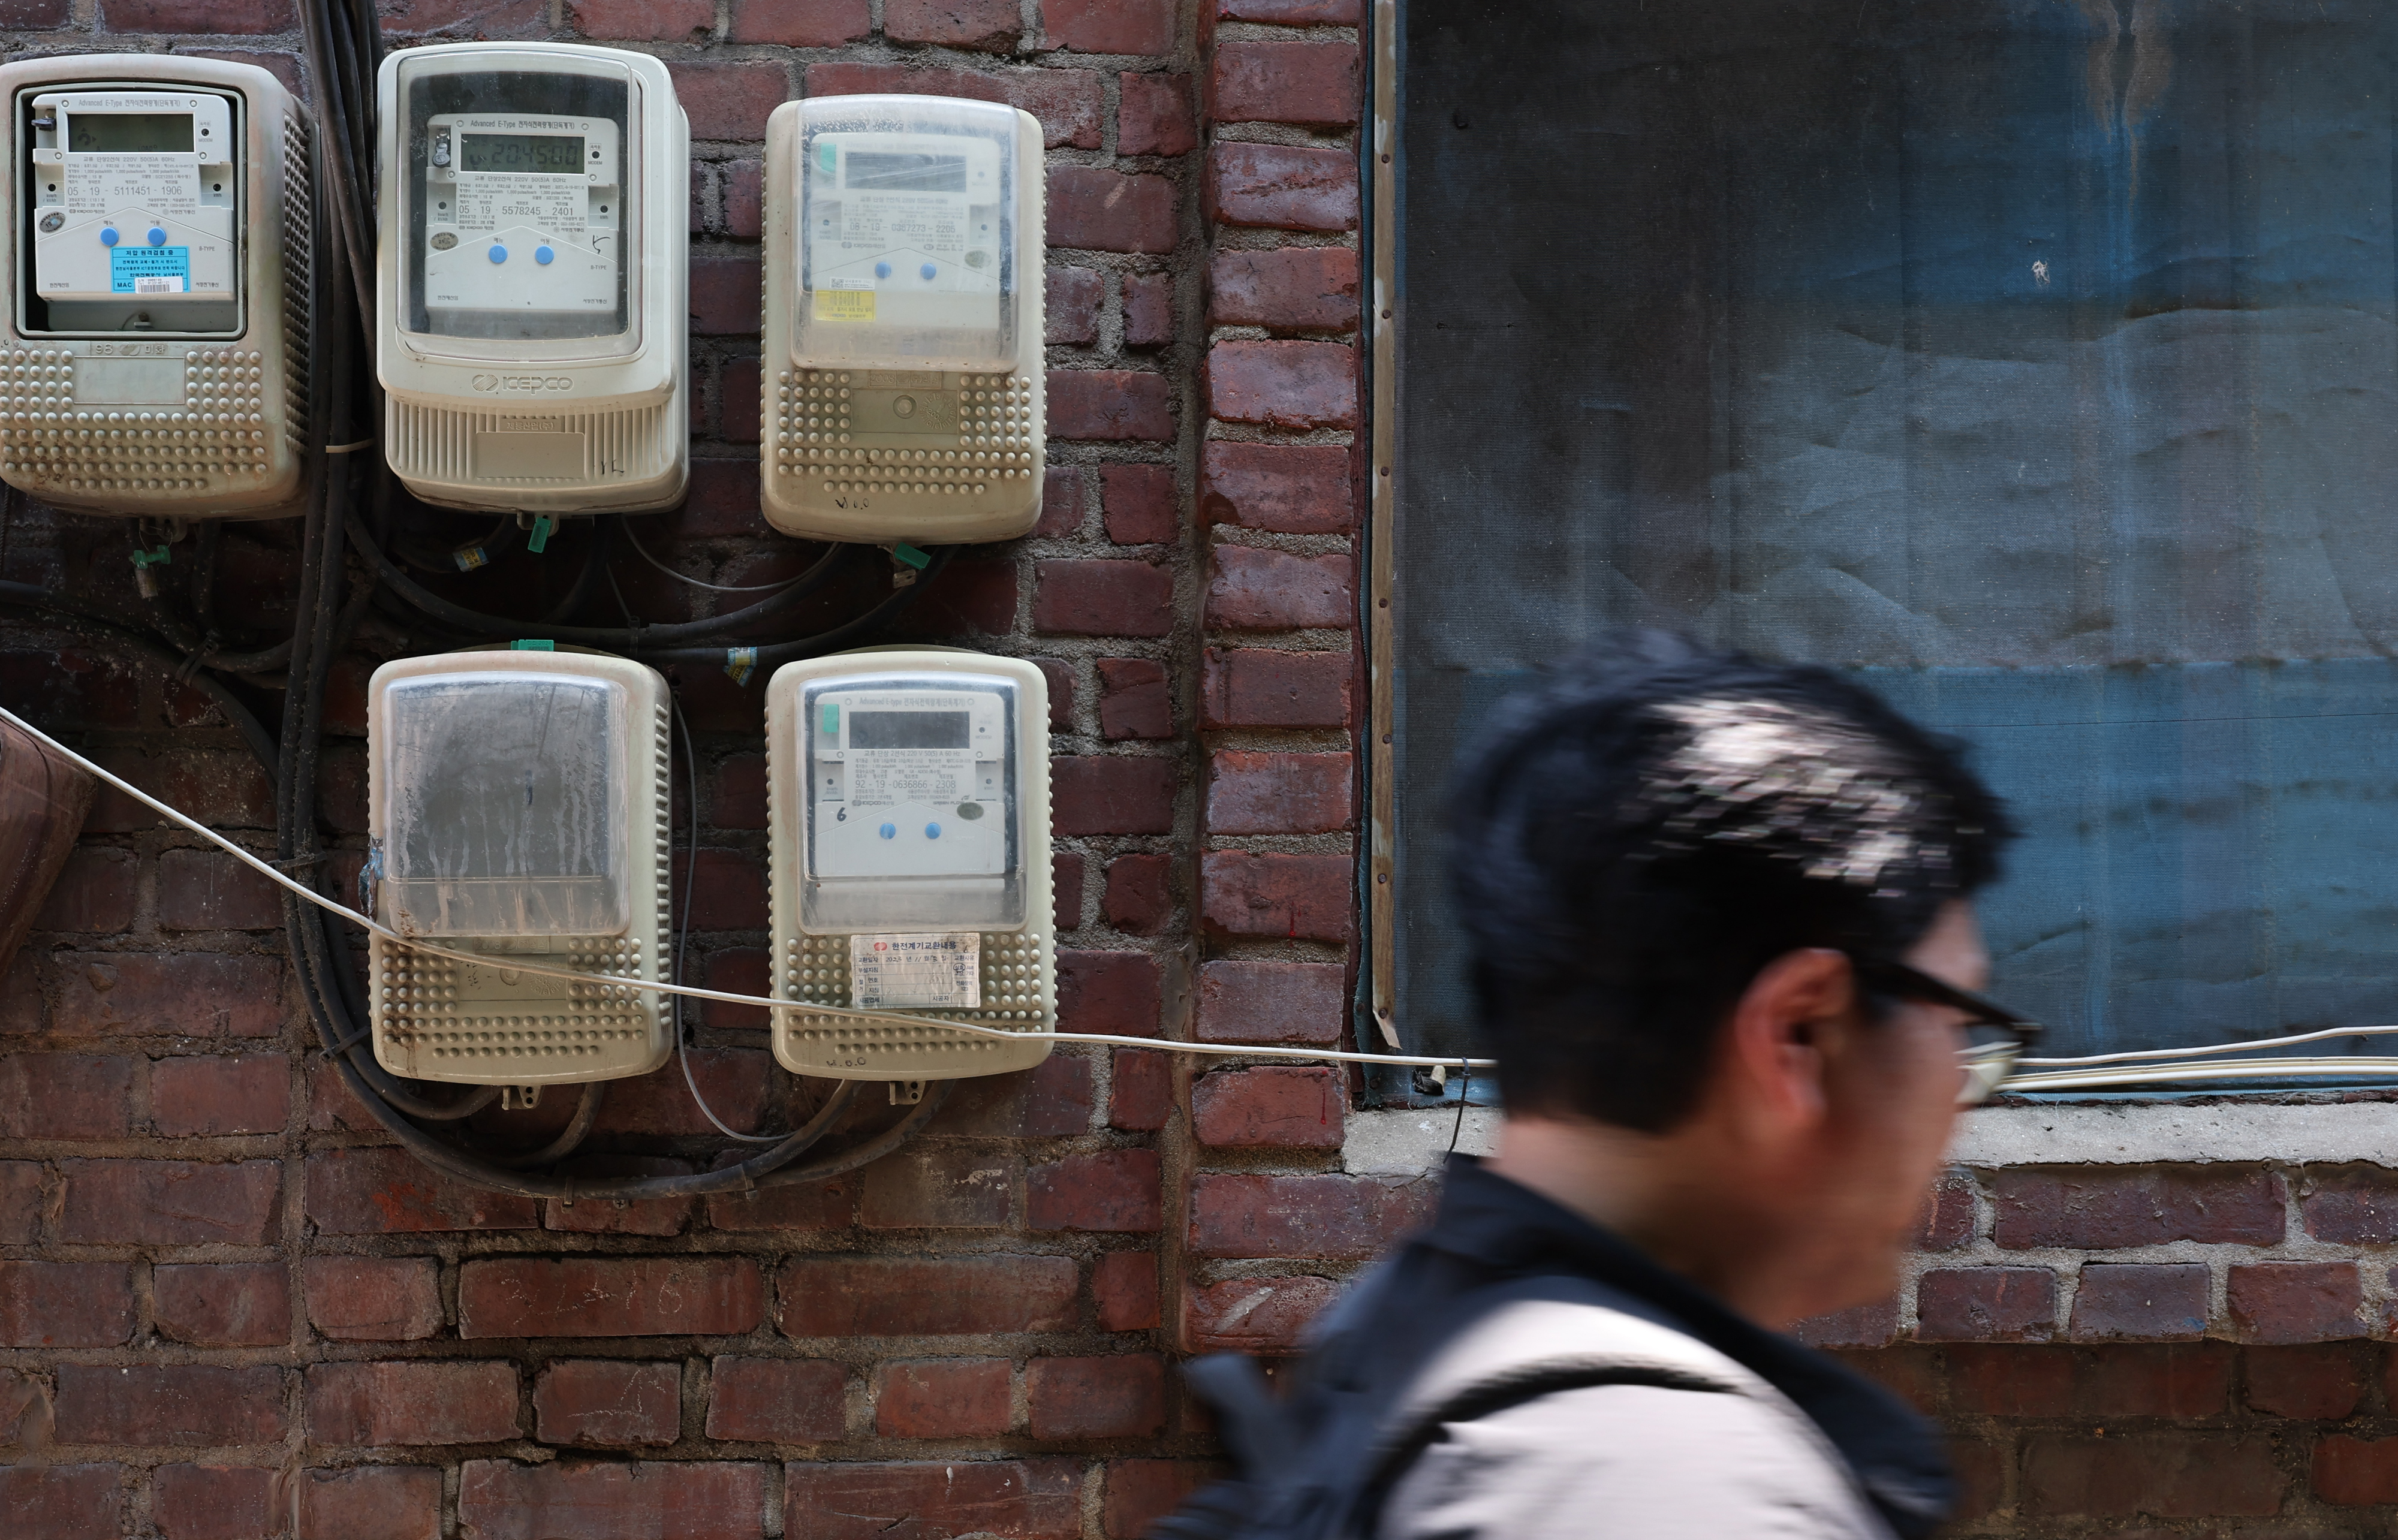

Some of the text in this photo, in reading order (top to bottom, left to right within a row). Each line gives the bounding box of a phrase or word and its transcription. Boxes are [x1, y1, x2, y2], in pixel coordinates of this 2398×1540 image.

[492, 144, 577, 165] 20:45:00
[68, 187, 78, 195] 05
[115, 186, 150, 195] 5111451
[162, 186, 182, 195] 1906
[481, 206, 490, 214] 19
[502, 206, 540, 215] 5578245
[96, 343, 113, 354] 98
[146, 345, 164, 354] 미화
[870, 374, 894, 382] 2008
[502, 376, 574, 394] KEPCO
[927, 409, 943, 422] 2008
[837, 807, 846, 821] 6
[892, 942, 956, 951] 한전계기교환내용
